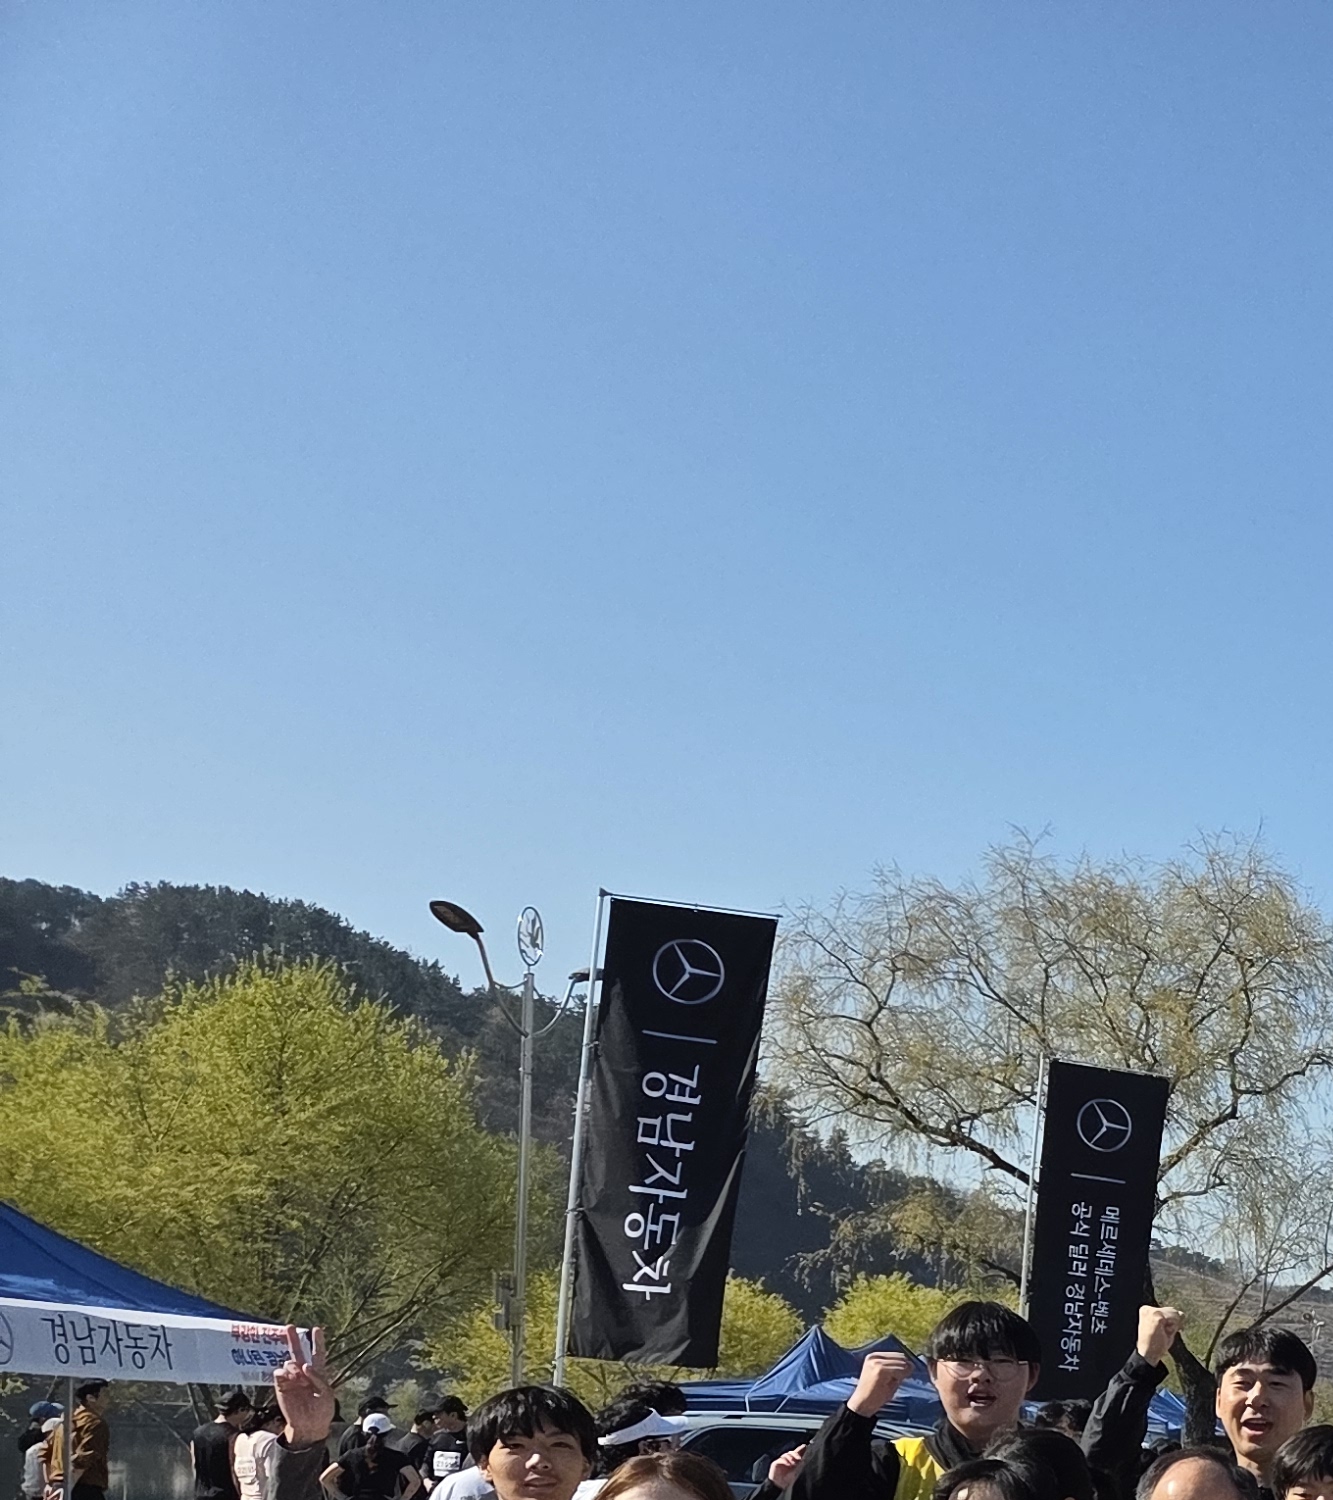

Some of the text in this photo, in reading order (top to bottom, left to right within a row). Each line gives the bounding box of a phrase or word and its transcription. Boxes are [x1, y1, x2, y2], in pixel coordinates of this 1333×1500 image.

[621, 1064, 702, 1301] 경남자동차
[40, 1314, 173, 1370] 경남자동차
[1057, 1202, 1093, 1373] 공식 딜러 경남자동차
[1090, 1204, 1121, 1335] 메르세데스-벤츠
